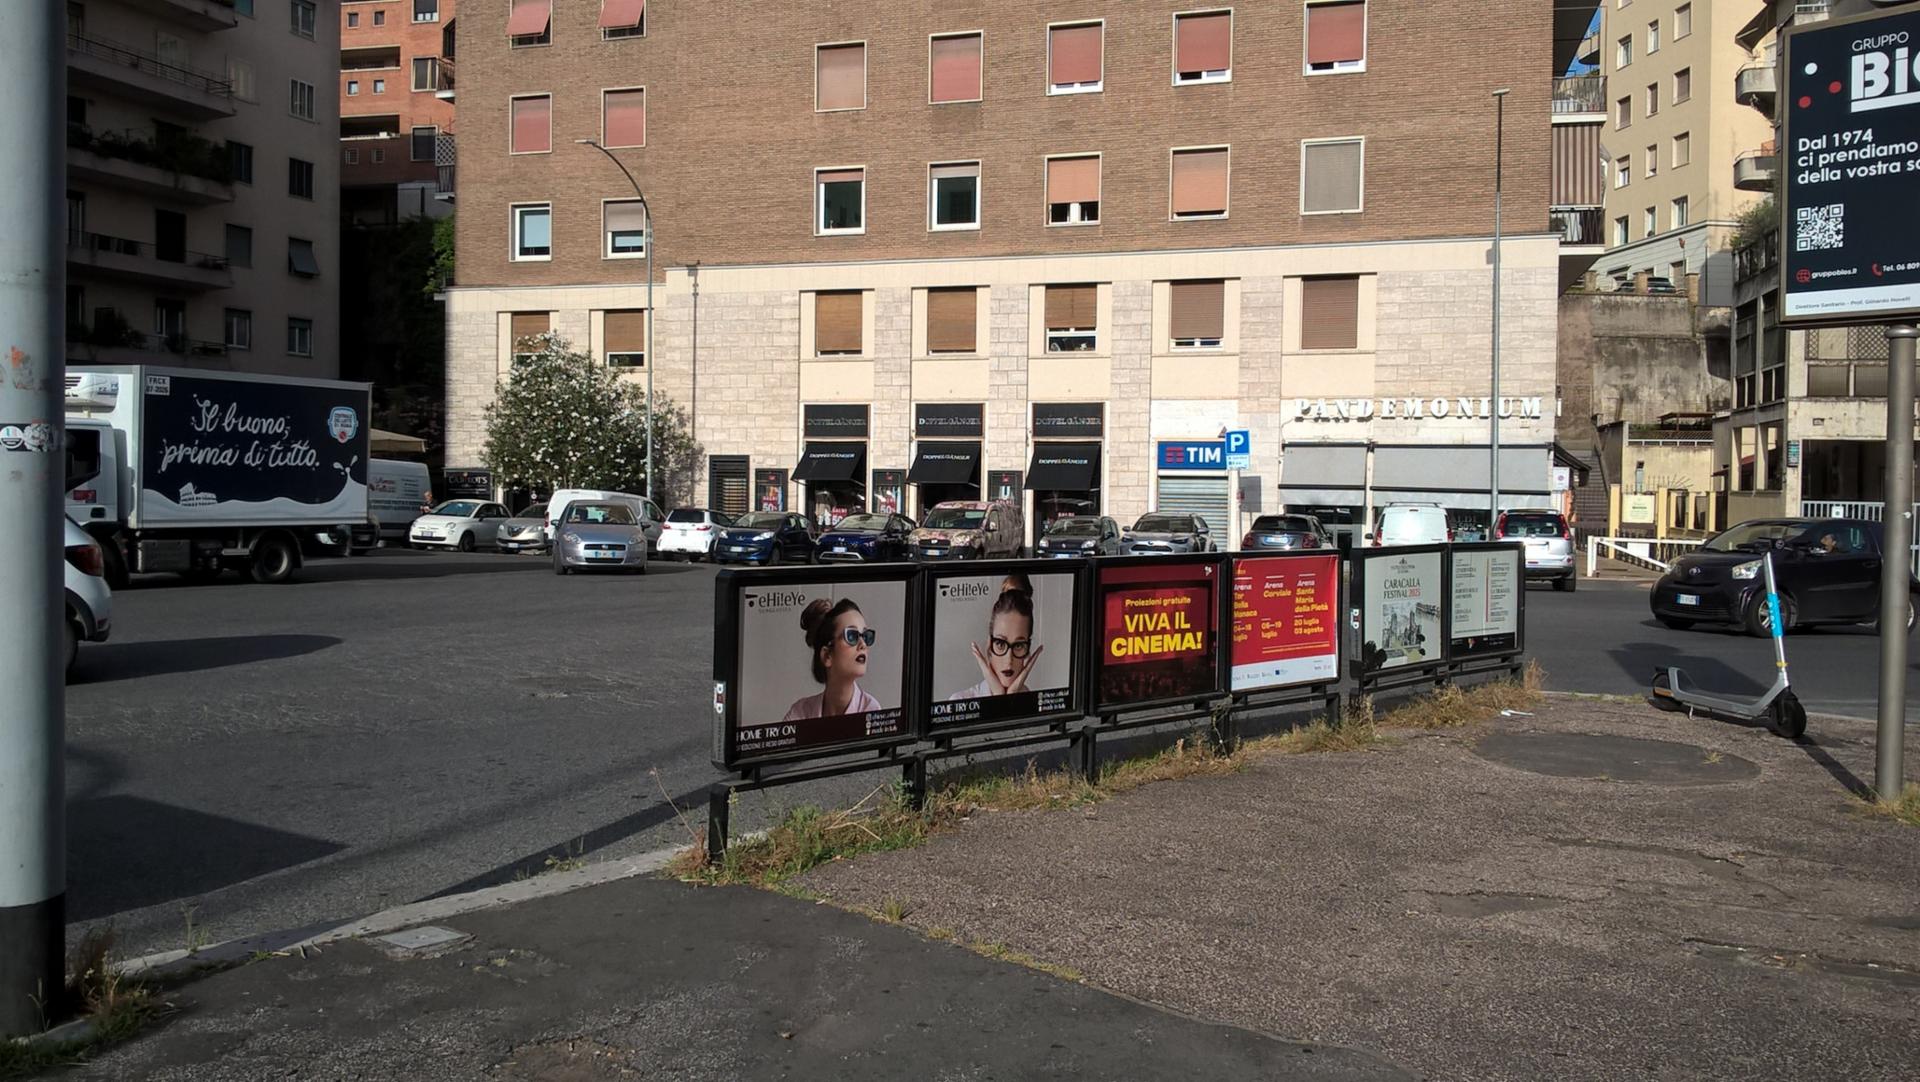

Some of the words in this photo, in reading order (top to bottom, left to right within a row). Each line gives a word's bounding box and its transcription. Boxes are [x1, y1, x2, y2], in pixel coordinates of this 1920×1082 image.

[1851, 31, 1909, 52] GRUPPO
[1851, 46, 1920, 100] Bi
[1798, 134, 1827, 152] Dal
[1832, 128, 1874, 147] 1974
[1797, 152, 1814, 168] ci
[1818, 141, 1919, 168] prendiamo
[1797, 166, 1842, 185] della
[1846, 160, 1901, 178] vostra
[1294, 397, 1544, 419] PANDEMONIUM
[222, 402, 290, 439] buono,
[1230, 433, 1244, 452] P
[160, 438, 240, 473] prima
[244, 440, 266, 467] di
[267, 440, 320, 468] tutto.
[1186, 447, 1221, 464] TIM
[1384, 577, 1421, 589] CARACALLA
[1125, 597, 1162, 607] Proiezioni
[1163, 596, 1191, 607] gratuite
[1383, 589, 1408, 599] FESTIVAL
[1124, 612, 1170, 633] VIVA
[1174, 612, 1191, 629] IL
[1111, 632, 1203, 657] CINEMA!
[931, 703, 953, 715] HOME
[955, 702, 968, 713] TRY
[969, 701, 981, 711] ON
[736, 728, 763, 742] HOME
[764, 726, 781, 738] TRY
[782, 724, 796, 736] ON
